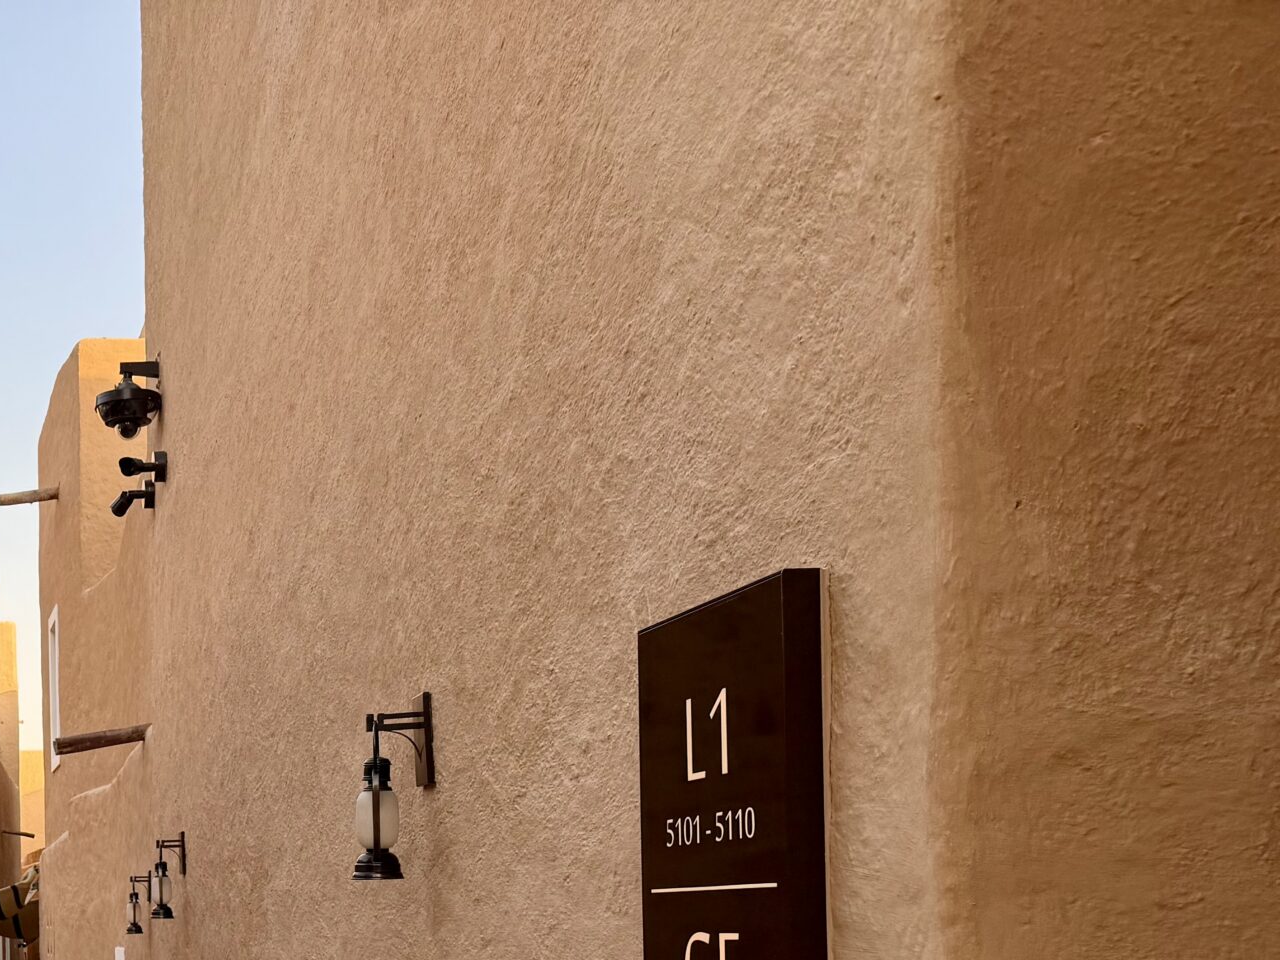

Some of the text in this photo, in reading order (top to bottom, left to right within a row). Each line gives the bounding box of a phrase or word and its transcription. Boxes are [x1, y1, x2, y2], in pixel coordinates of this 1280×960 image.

[685, 687, 729, 782] L1
[666, 815, 700, 848] 5101
[715, 806, 756, 842] 5110
